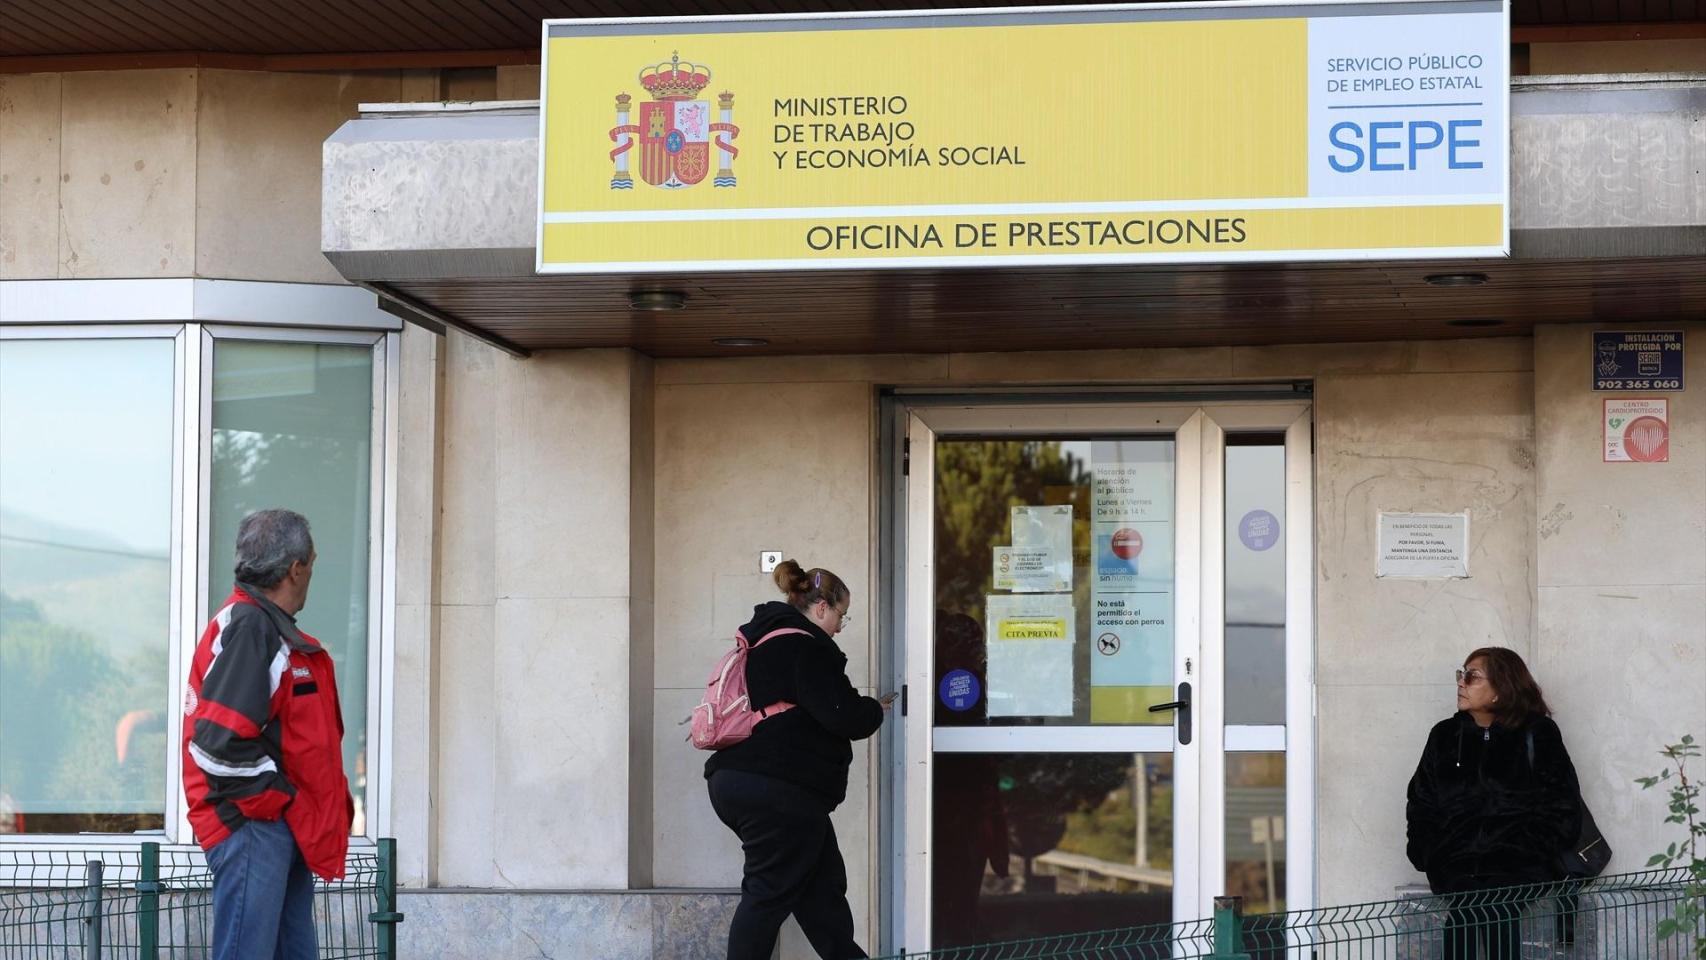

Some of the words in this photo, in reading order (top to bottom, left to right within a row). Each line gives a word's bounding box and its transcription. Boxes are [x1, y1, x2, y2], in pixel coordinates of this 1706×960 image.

[1327, 57, 1402, 72] SERVICIO
[1408, 53, 1483, 70] PÚBLICO
[1327, 79, 1348, 92] DE
[1353, 78, 1414, 92] EMPLEO
[1419, 76, 1483, 90] ESTATAL
[774, 96, 907, 117] MINISTERIO
[774, 124, 804, 143] DE
[809, 121, 915, 146] TRABAJO
[1327, 119, 1484, 173] SEPE
[773, 150, 788, 169] Y
[796, 143, 931, 169] ECONOMÍA
[938, 146, 1026, 166] SOCIAL
[806, 223, 944, 251] OFICINA
[955, 223, 997, 248] DE
[1008, 217, 1247, 247] PRESTACIONES
[1618, 343, 1661, 351] PROTEGIDA
[1665, 342, 1681, 351] POR
[1598, 380, 1623, 389] 902
[1626, 380, 1650, 389] 365
[1653, 380, 1679, 389] 060
[1106, 487, 1134, 495] público
[1097, 609, 1133, 617] permitido
[1141, 619, 1165, 627] perros
